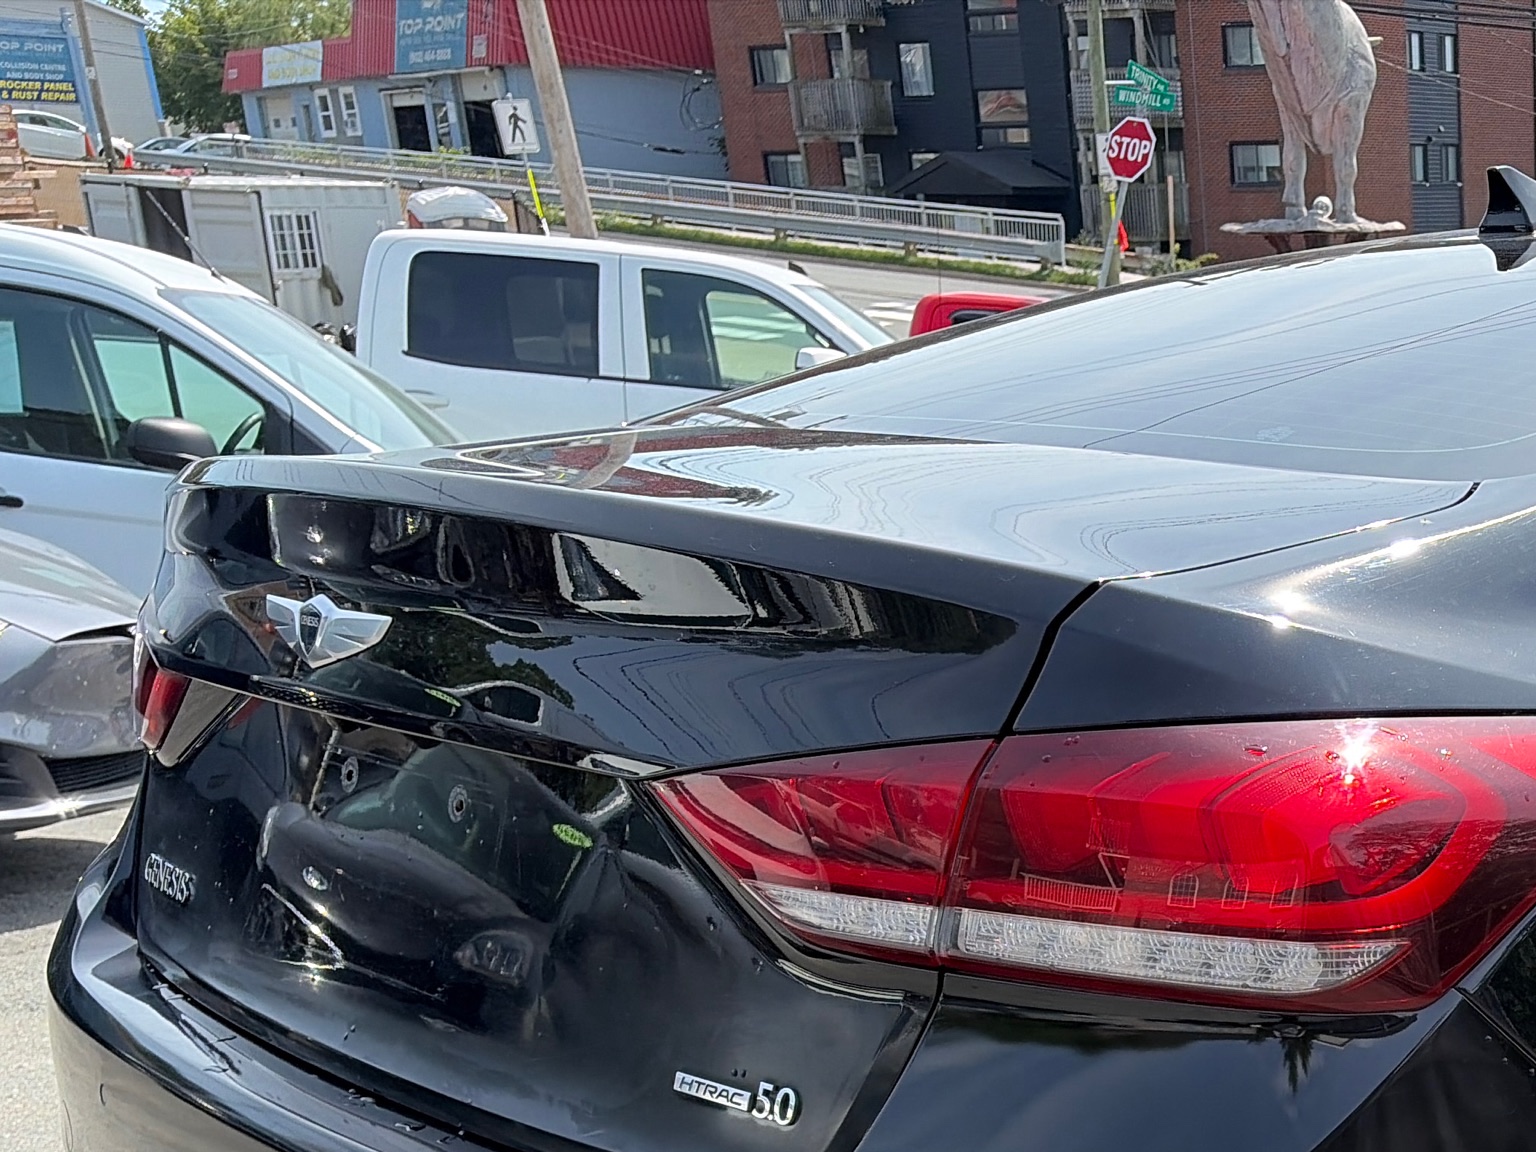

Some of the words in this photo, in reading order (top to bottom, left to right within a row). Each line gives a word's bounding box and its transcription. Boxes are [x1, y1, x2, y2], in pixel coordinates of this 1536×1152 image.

[399, 18, 421, 35] TOP
[424, 12, 465, 33] POINT
[0, 40, 20, 51] OP
[24, 42, 65, 53] POINT
[0, 61, 39, 70] COLLISION
[40, 63, 66, 72] CENTRE
[24, 71, 44, 80] BODY
[45, 72, 64, 81] SHOP
[0, 80, 42, 90] ROCKER
[43, 81, 75, 91] PANEL
[1130, 65, 1159, 92] TRINITY
[1, 89, 9, 99] &
[12, 90, 39, 100] RUST
[41, 91, 77, 102] REPAIR
[1118, 88, 1162, 107] WINDMILL
[1109, 135, 1151, 163] STOP
[145, 852, 193, 903] GENESIS
[679, 1076, 744, 1106] HTRAC
[751, 1081, 796, 1126] 5.0
